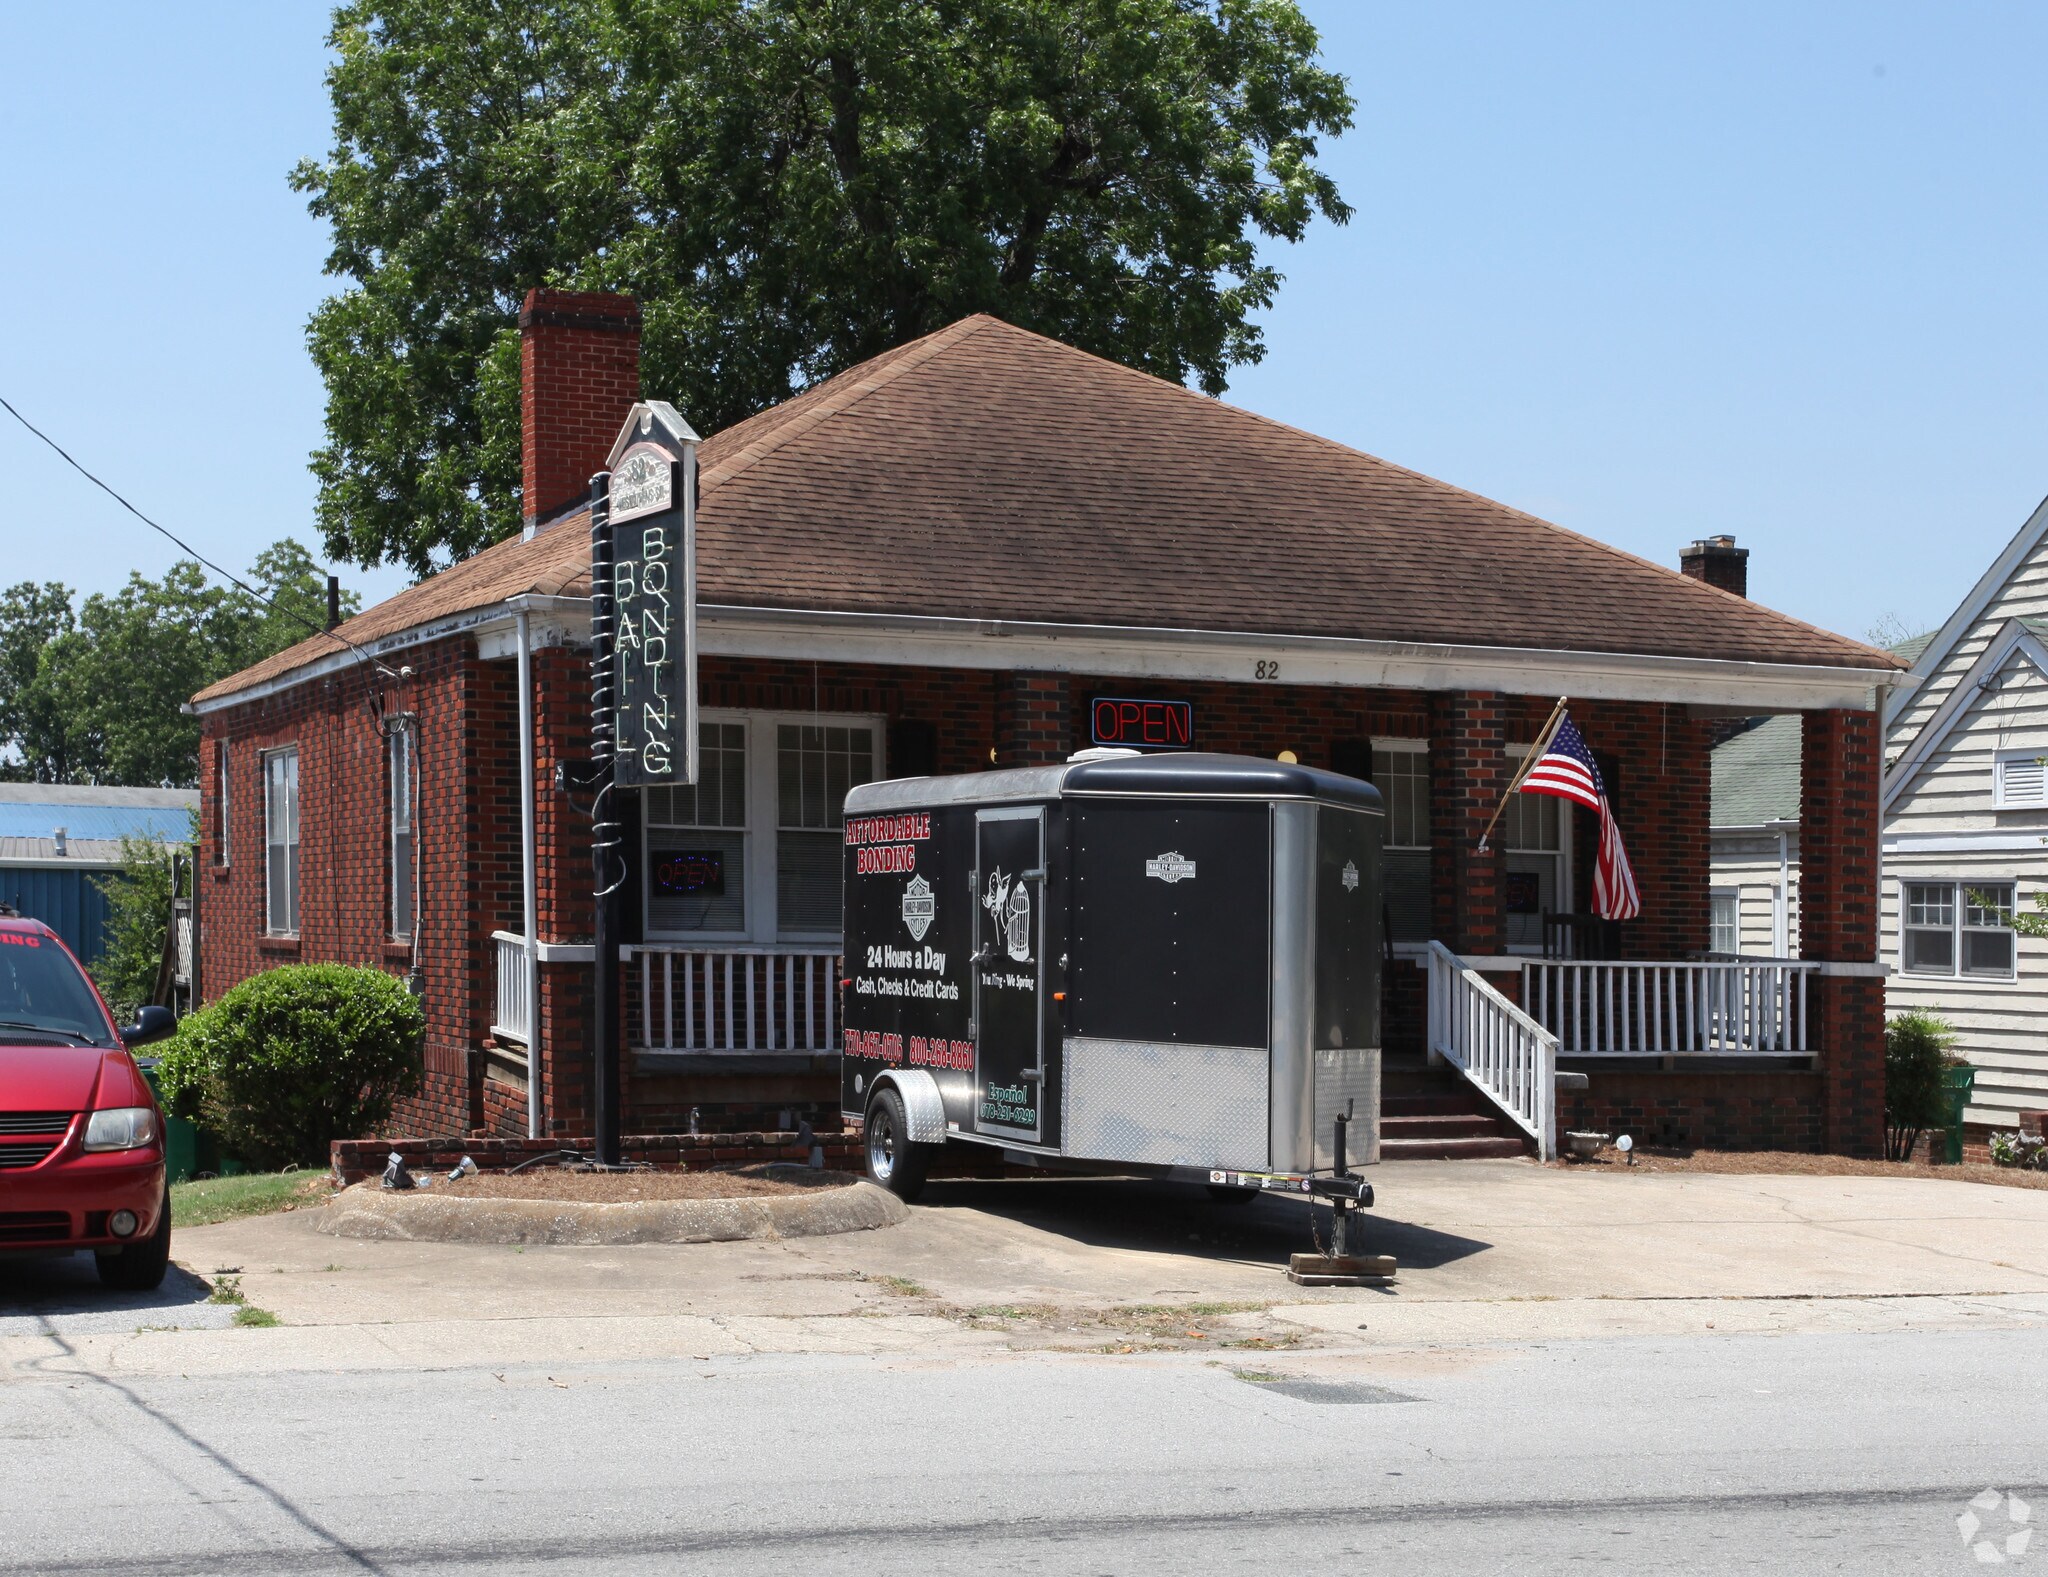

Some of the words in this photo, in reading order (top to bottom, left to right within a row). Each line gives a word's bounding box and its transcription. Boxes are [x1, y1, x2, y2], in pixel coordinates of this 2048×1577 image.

[615, 561, 640, 752] BAIL
[643, 527, 670, 773] BONDING
[1255, 660, 1279, 680] 82
[1096, 702, 1188, 744] OPEN
[845, 812, 931, 846] AFFORDABLE
[857, 844, 916, 875] BONDING
[1149, 863, 1193, 872] HARLEY-DAVIDSON
[658, 863, 720, 883] OPEN
[0, 933, 41, 948] ING
[867, 945, 883, 968] 24
[884, 945, 912, 969] Hours
[914, 951, 922, 969] a
[924, 946, 946, 976] Day
[856, 976, 877, 997] Cash,
[878, 977, 903, 996] Checks
[904, 978, 910, 997] &
[911, 978, 934, 998] Credit
[935, 980, 959, 1000] Cards
[1006, 974, 1015, 987] We
[1016, 974, 1034, 991] Spring
[845, 1028, 903, 1062] 770-867-0706
[909, 1035, 974, 1072] 800-268-8860
[987, 1081, 1028, 1105] Español
[980, 1102, 1036, 1125] 678-231-6299
